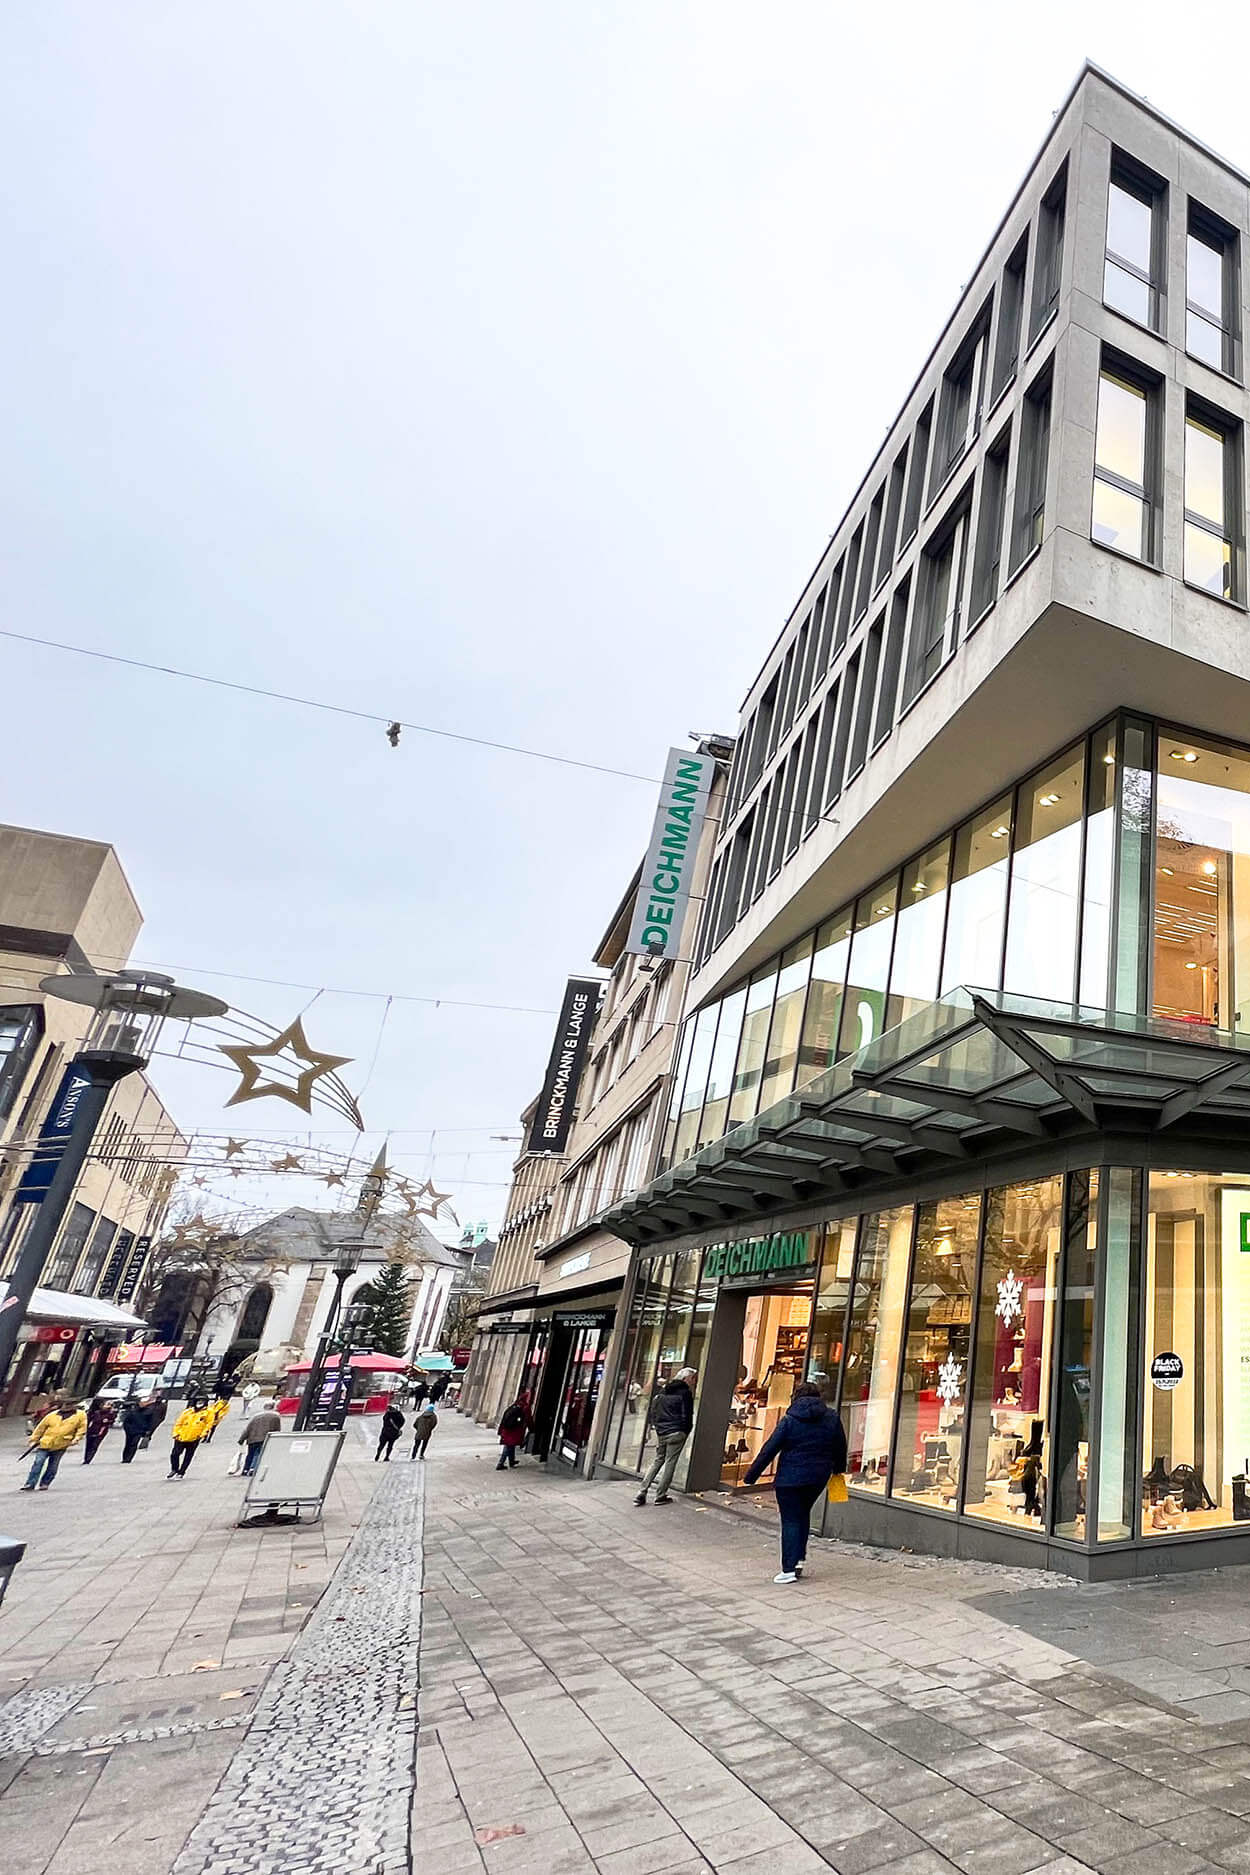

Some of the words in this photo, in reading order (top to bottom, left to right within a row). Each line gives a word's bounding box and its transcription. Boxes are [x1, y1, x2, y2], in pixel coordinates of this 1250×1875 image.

[641, 758, 703, 947] DEICHMANN
[566, 993, 588, 1037] LANGE
[564, 1039, 578, 1049] &
[543, 1050, 576, 1138] BRINCKMANN
[121, 1240, 148, 1295] RESERVED
[704, 1231, 810, 1278] DEICHMANN
[1155, 1358, 1180, 1366] BLACK
